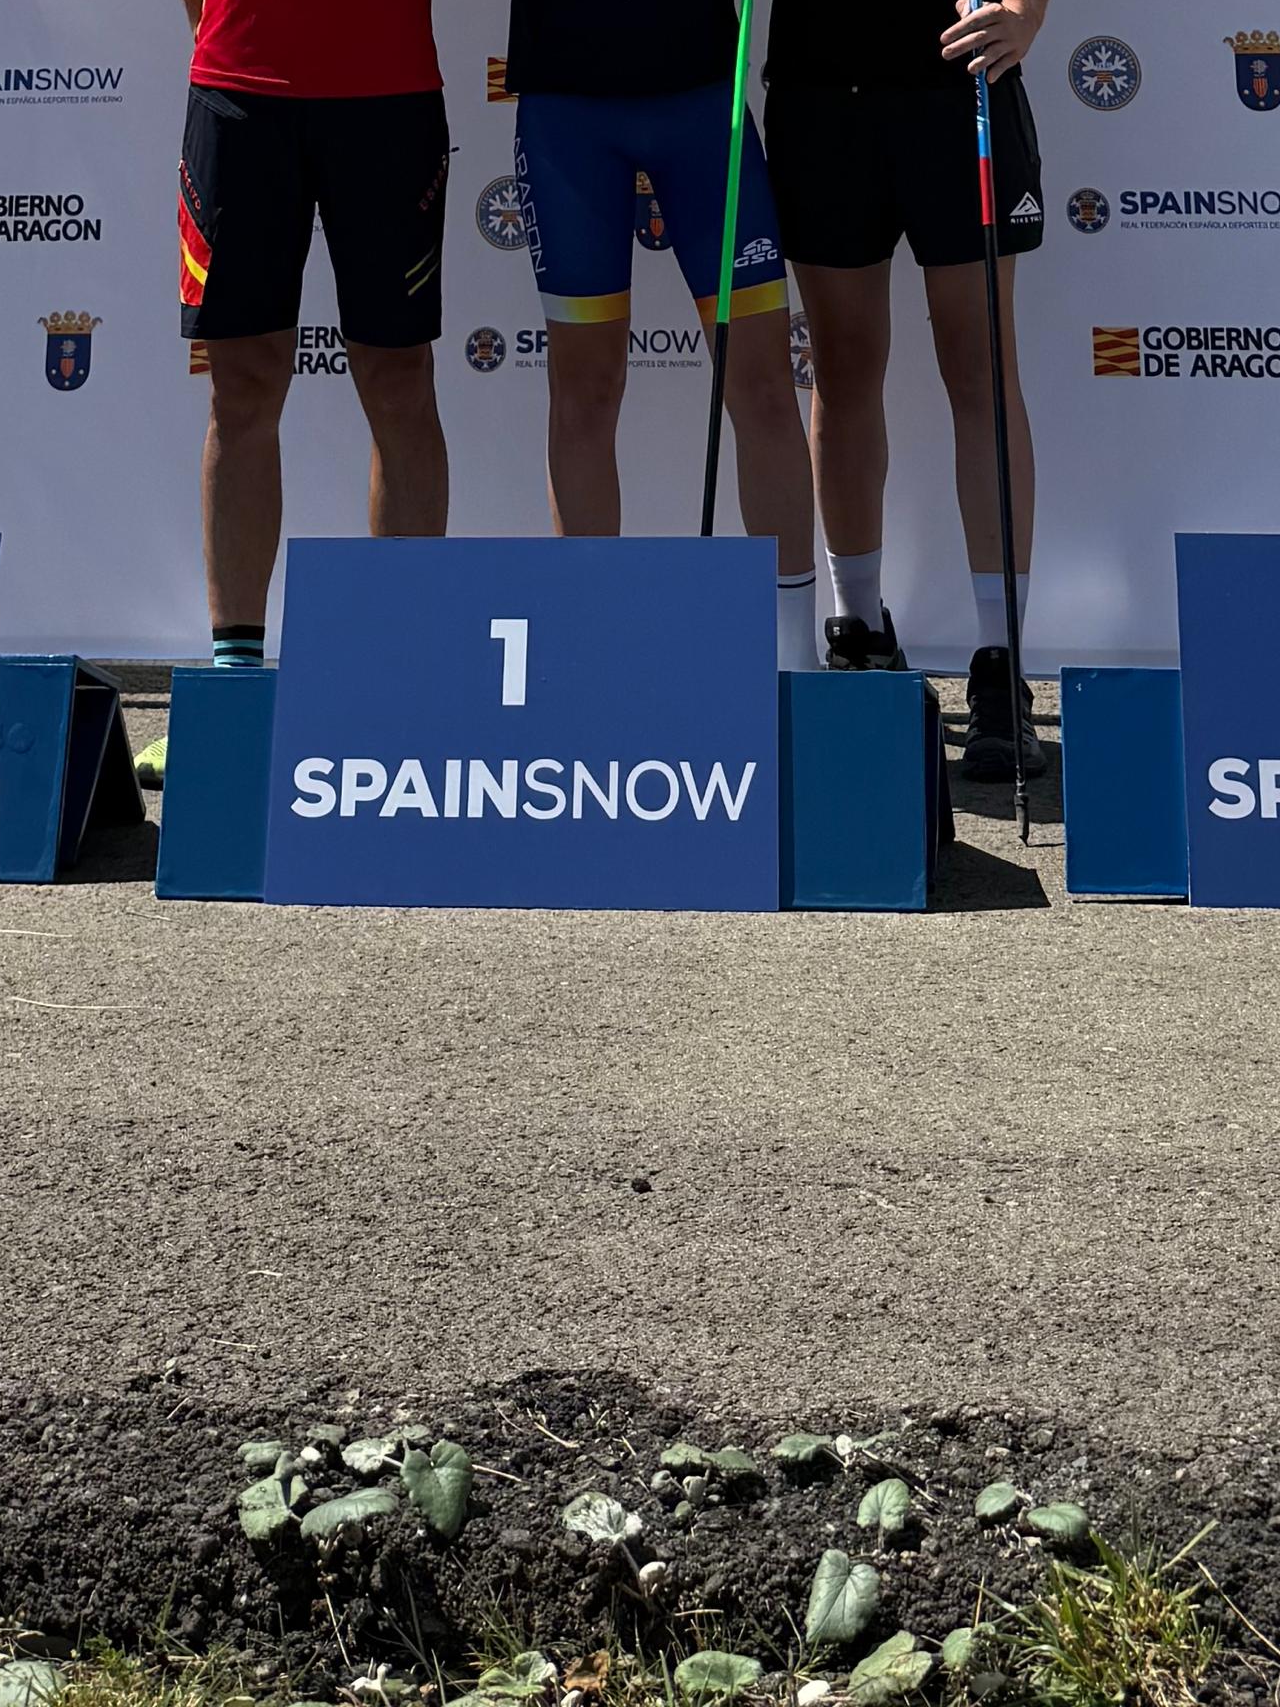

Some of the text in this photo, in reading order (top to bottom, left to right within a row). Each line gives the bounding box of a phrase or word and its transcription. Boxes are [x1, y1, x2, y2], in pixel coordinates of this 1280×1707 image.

[733, 248, 778, 269] GSG
[1144, 353, 1180, 377] DE
[490, 618, 528, 706] 1
[291, 758, 757, 822] SPAINSNOW
